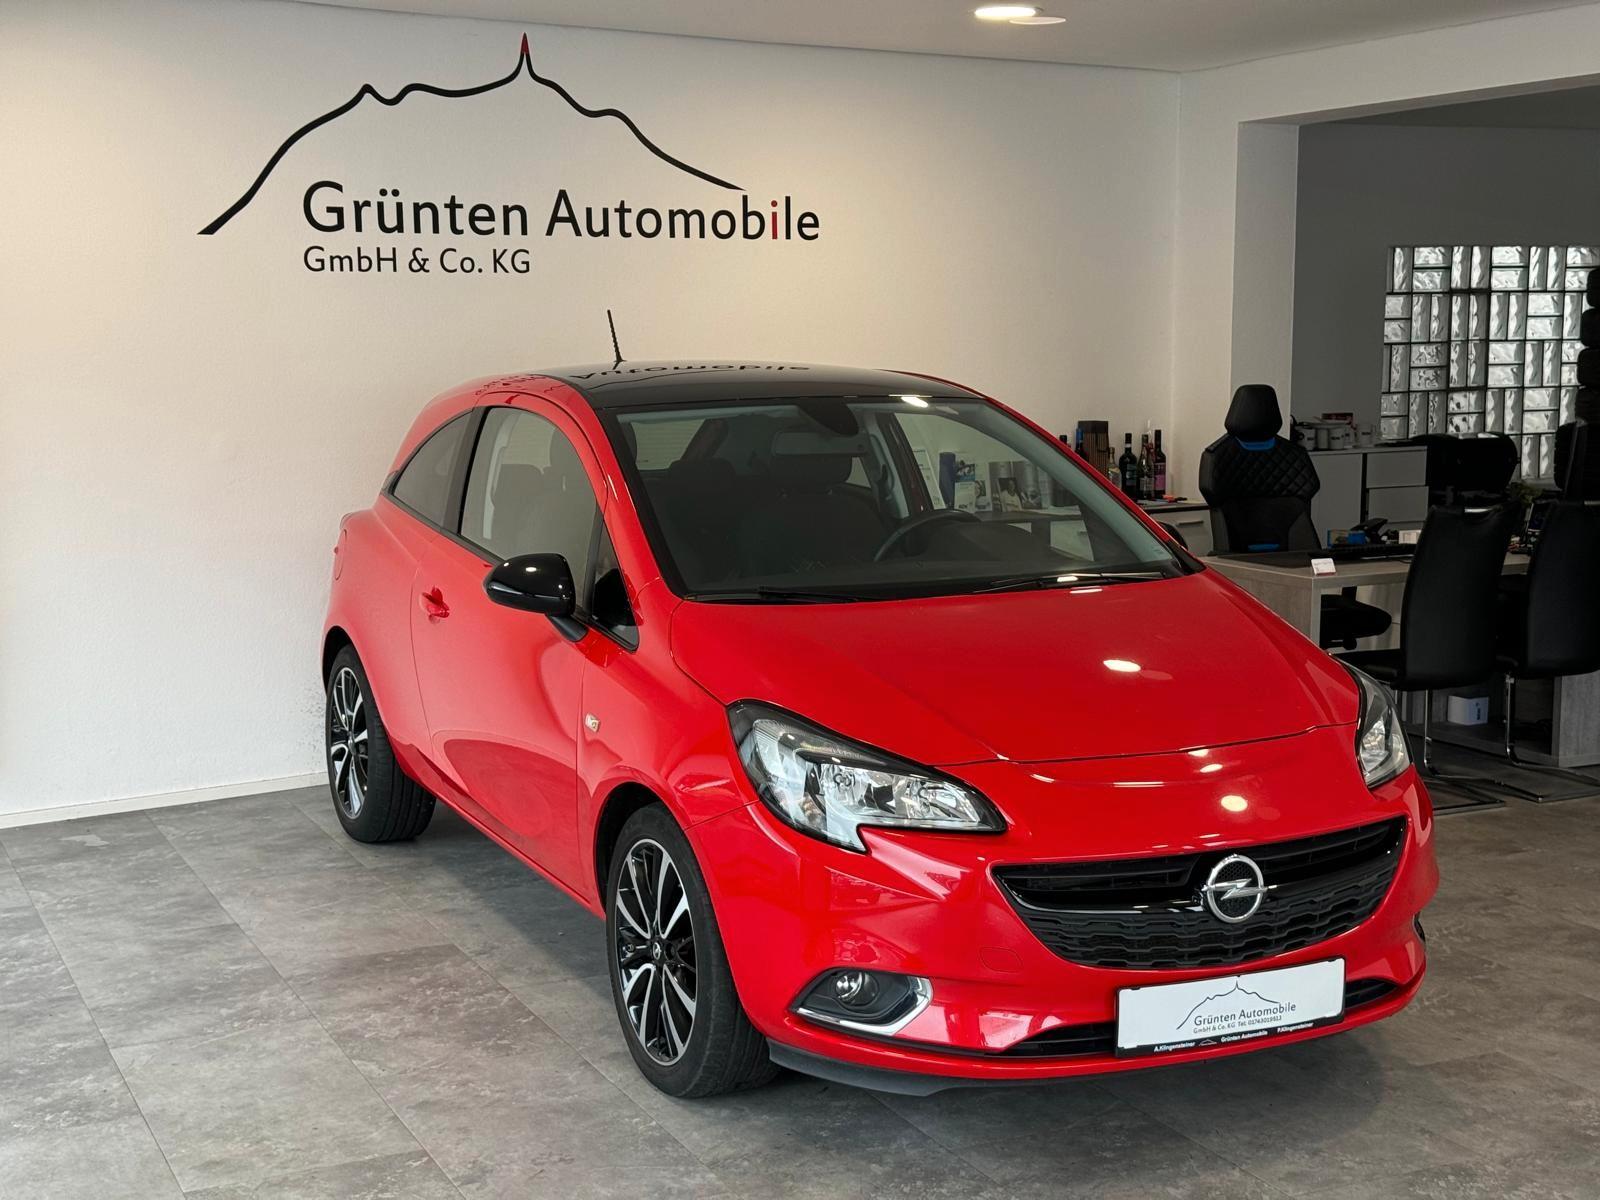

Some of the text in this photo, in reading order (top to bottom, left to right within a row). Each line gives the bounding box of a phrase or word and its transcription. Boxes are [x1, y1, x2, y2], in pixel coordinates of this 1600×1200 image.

[303, 180, 820, 241] Grünten Automobile
[304, 245, 530, 275] GmbH & Co. KG
[1194, 1001, 1296, 1026] Grünten Automobile
